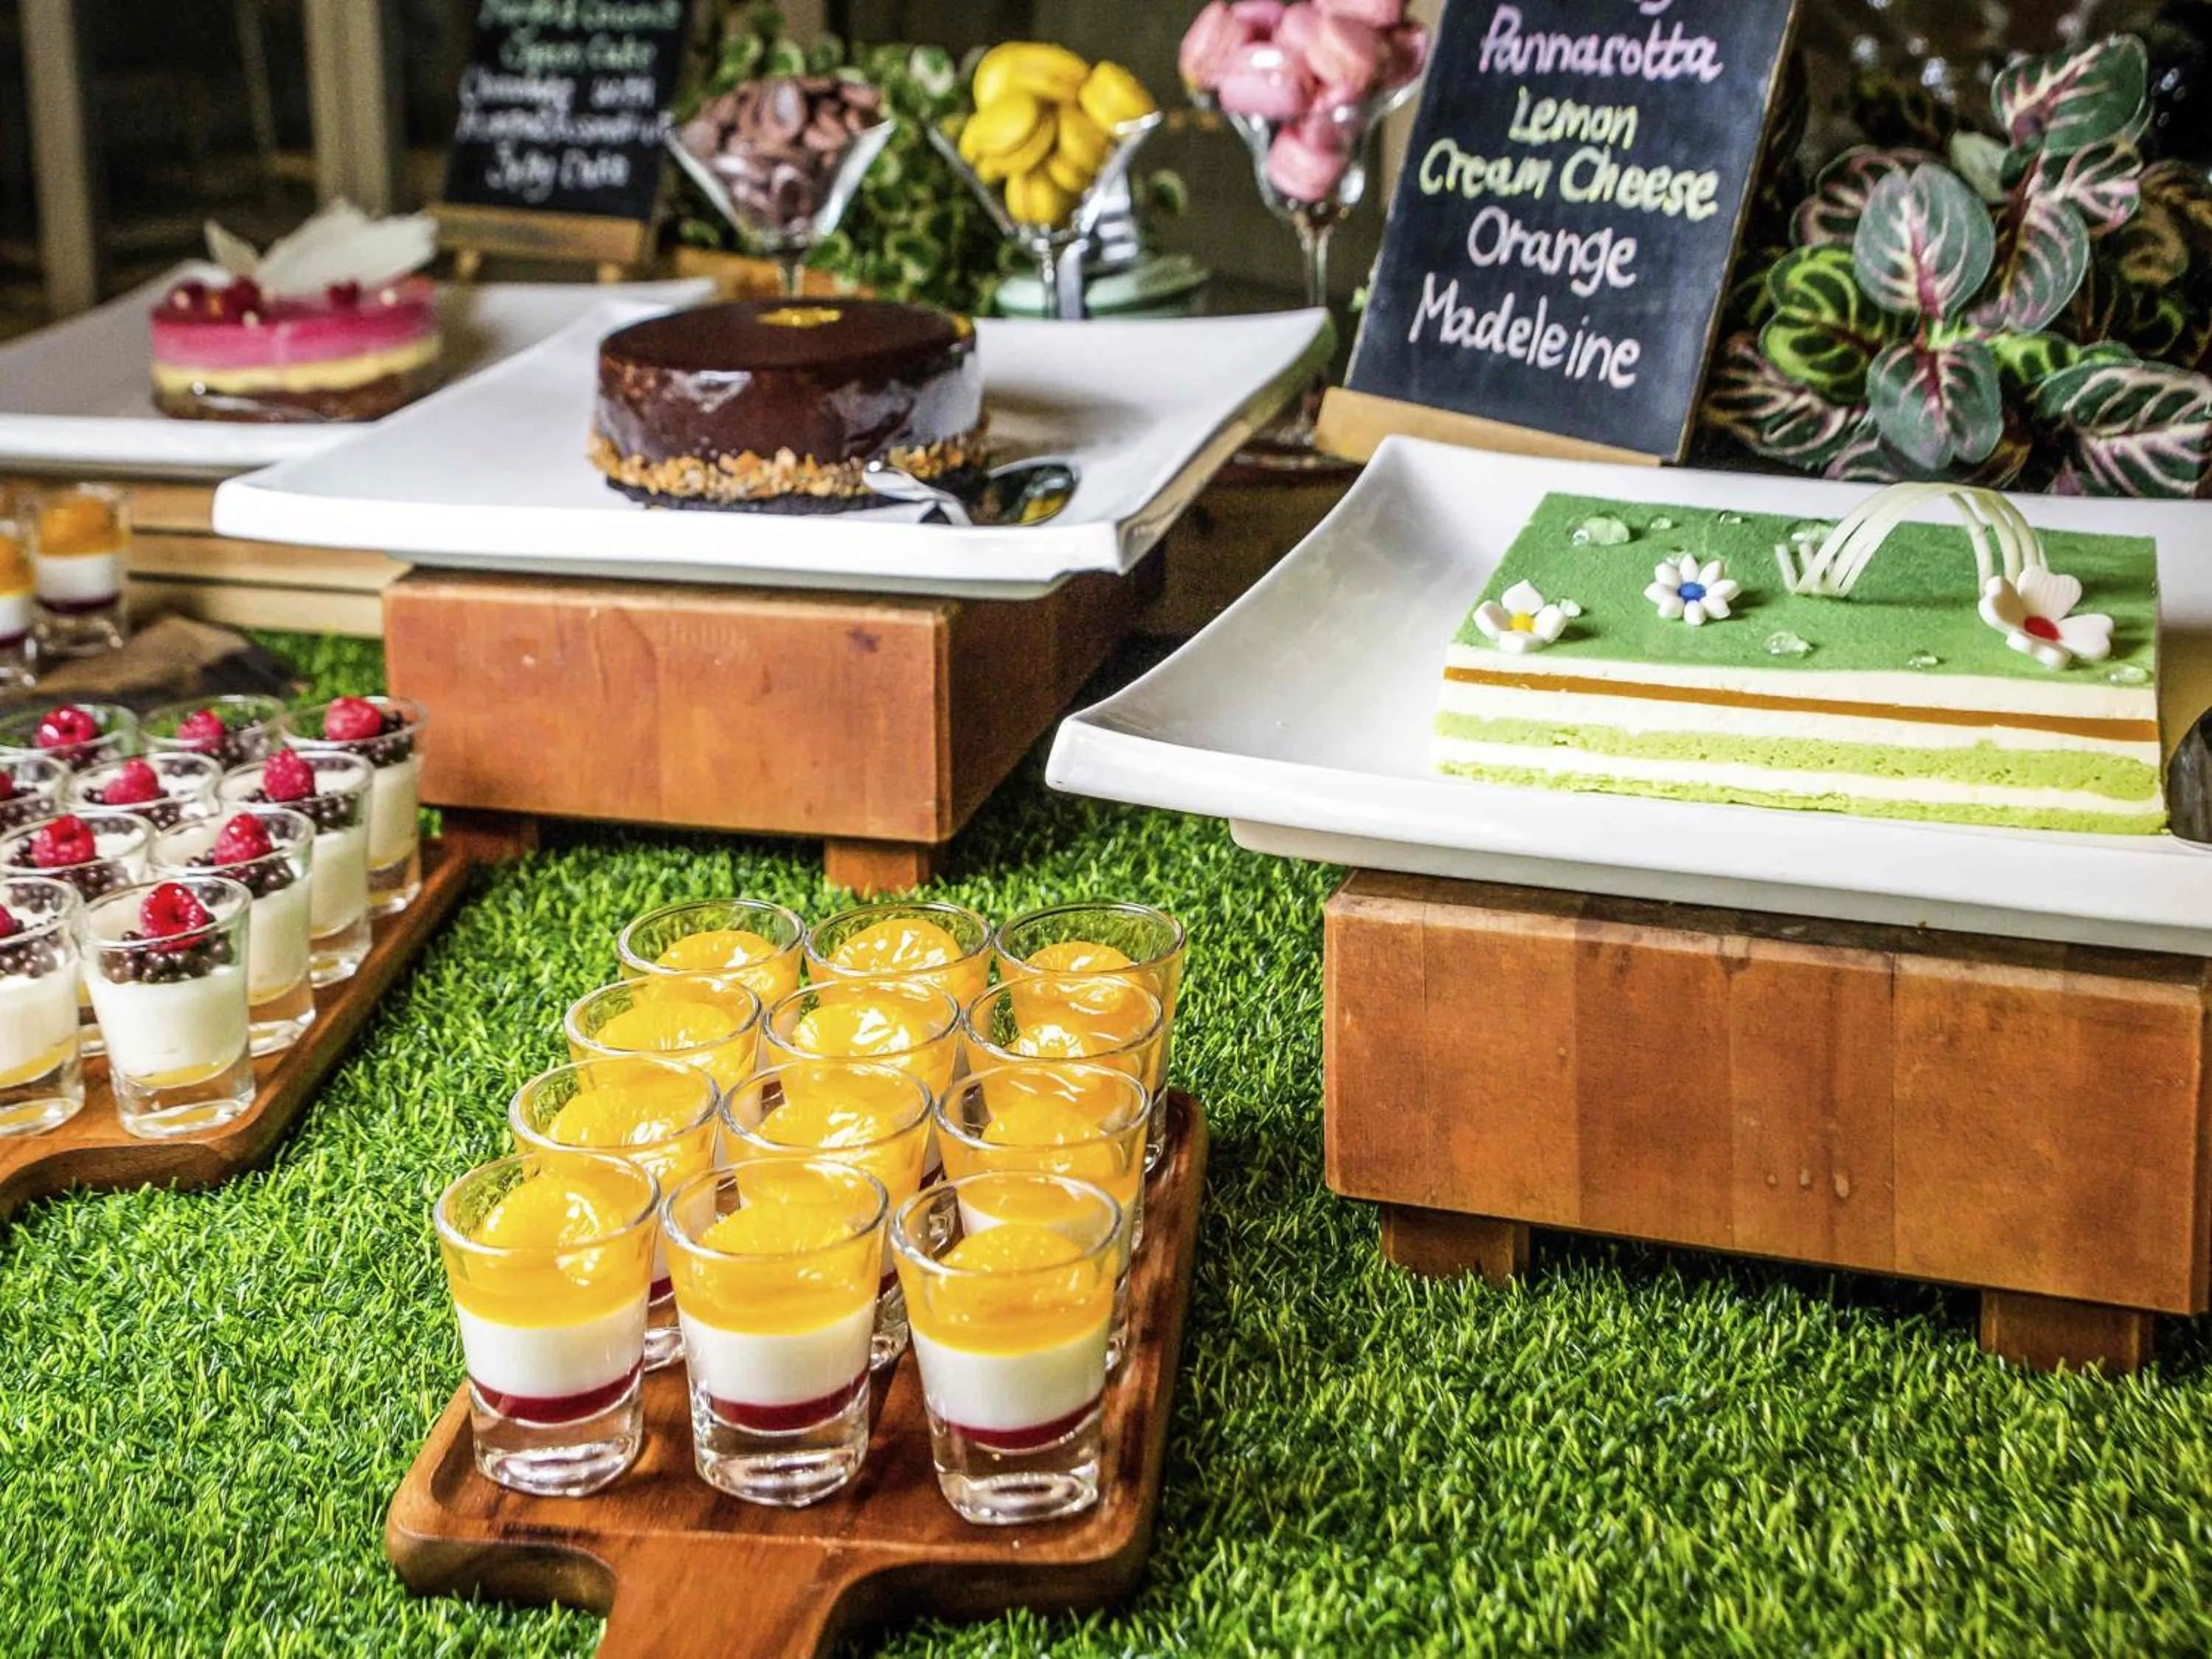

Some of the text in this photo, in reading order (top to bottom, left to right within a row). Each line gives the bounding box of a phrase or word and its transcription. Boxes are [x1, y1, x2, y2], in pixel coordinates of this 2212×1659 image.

[1508, 85, 1638, 150] Lemon
[1419, 137, 1719, 220] Cream Cheese
[1467, 206, 1638, 296] Orange
[1408, 271, 1641, 388] Madeleine
